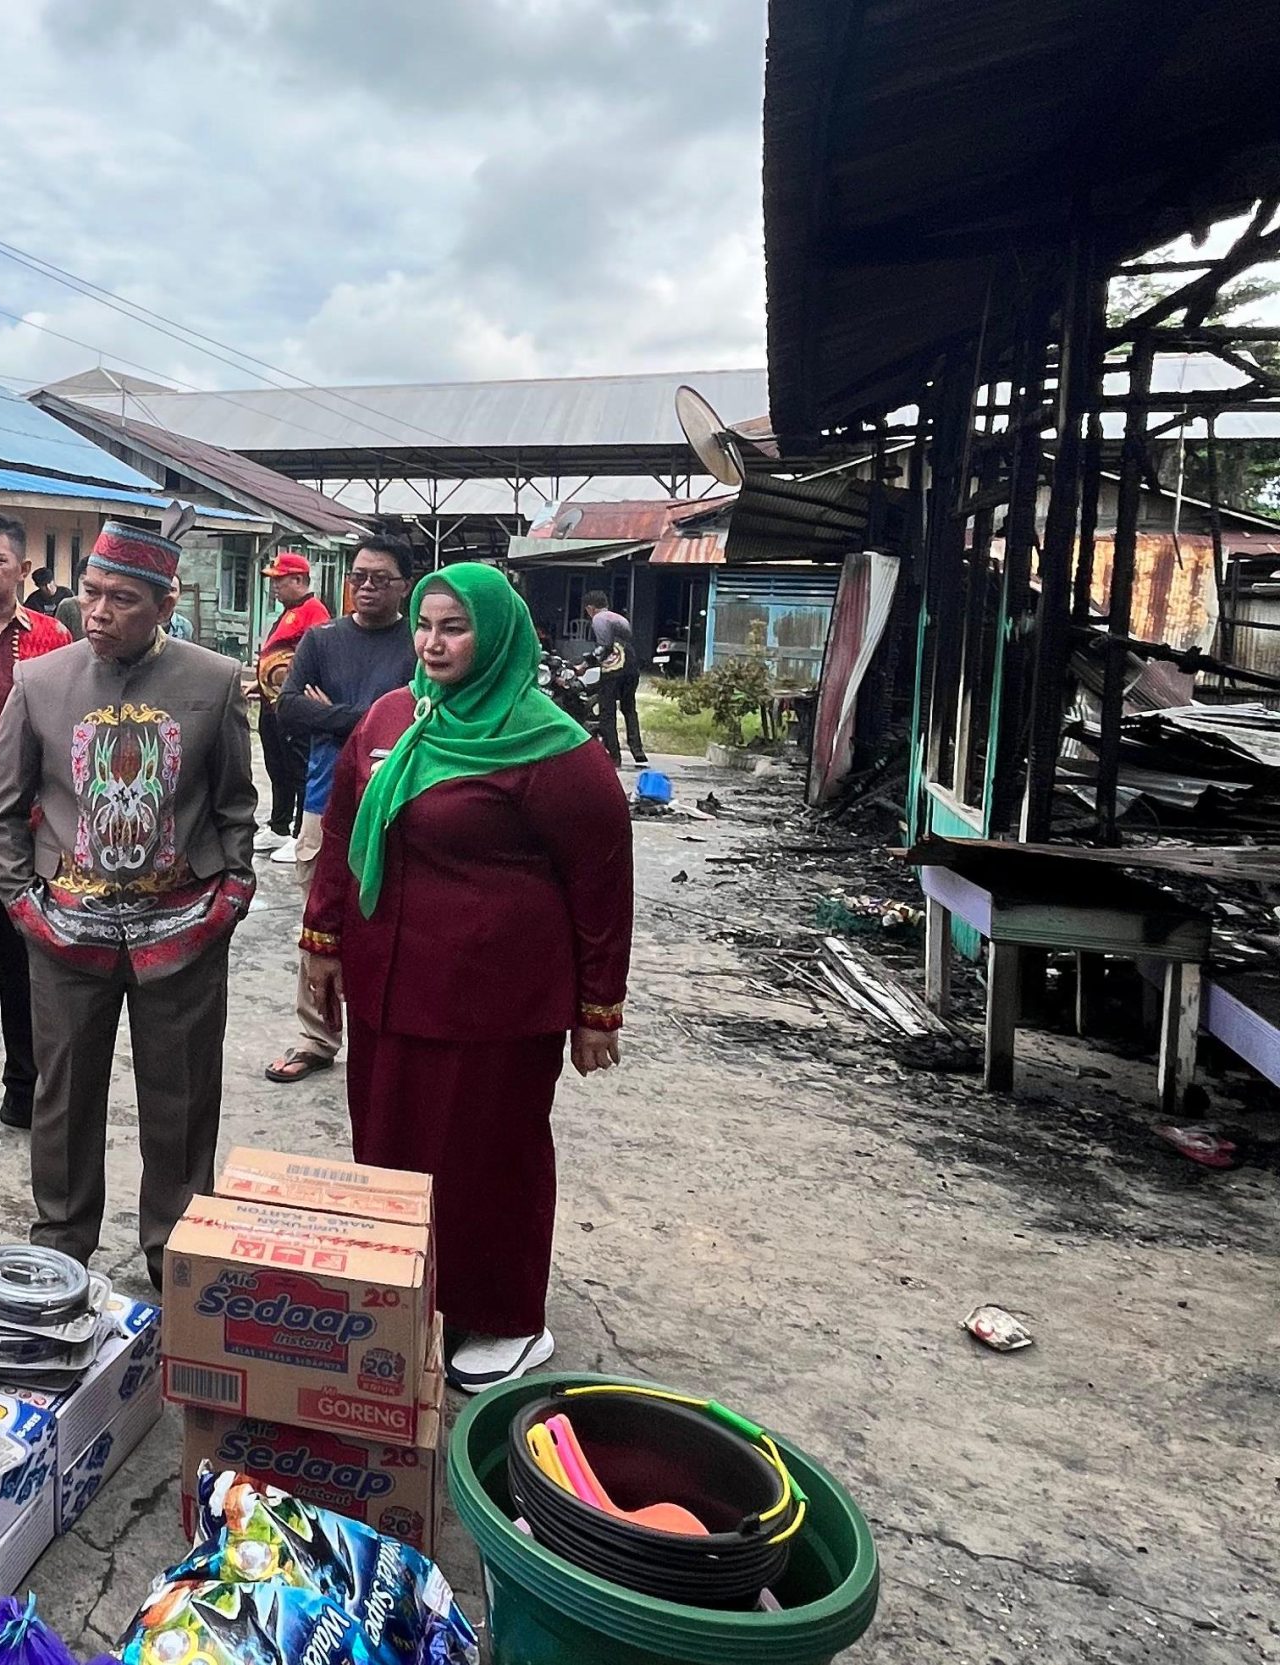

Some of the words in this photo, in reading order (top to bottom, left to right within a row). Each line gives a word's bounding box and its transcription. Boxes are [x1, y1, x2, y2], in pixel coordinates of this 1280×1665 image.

[236, 1205, 305, 1221] KARTON
[220, 1270, 259, 1289] Mie
[361, 1287, 401, 1308] 20
[195, 1283, 377, 1344] Sedaap
[318, 1397, 406, 1428] GORENG
[216, 1430, 396, 1500] Sedaap
[380, 1447, 419, 1468] 20
